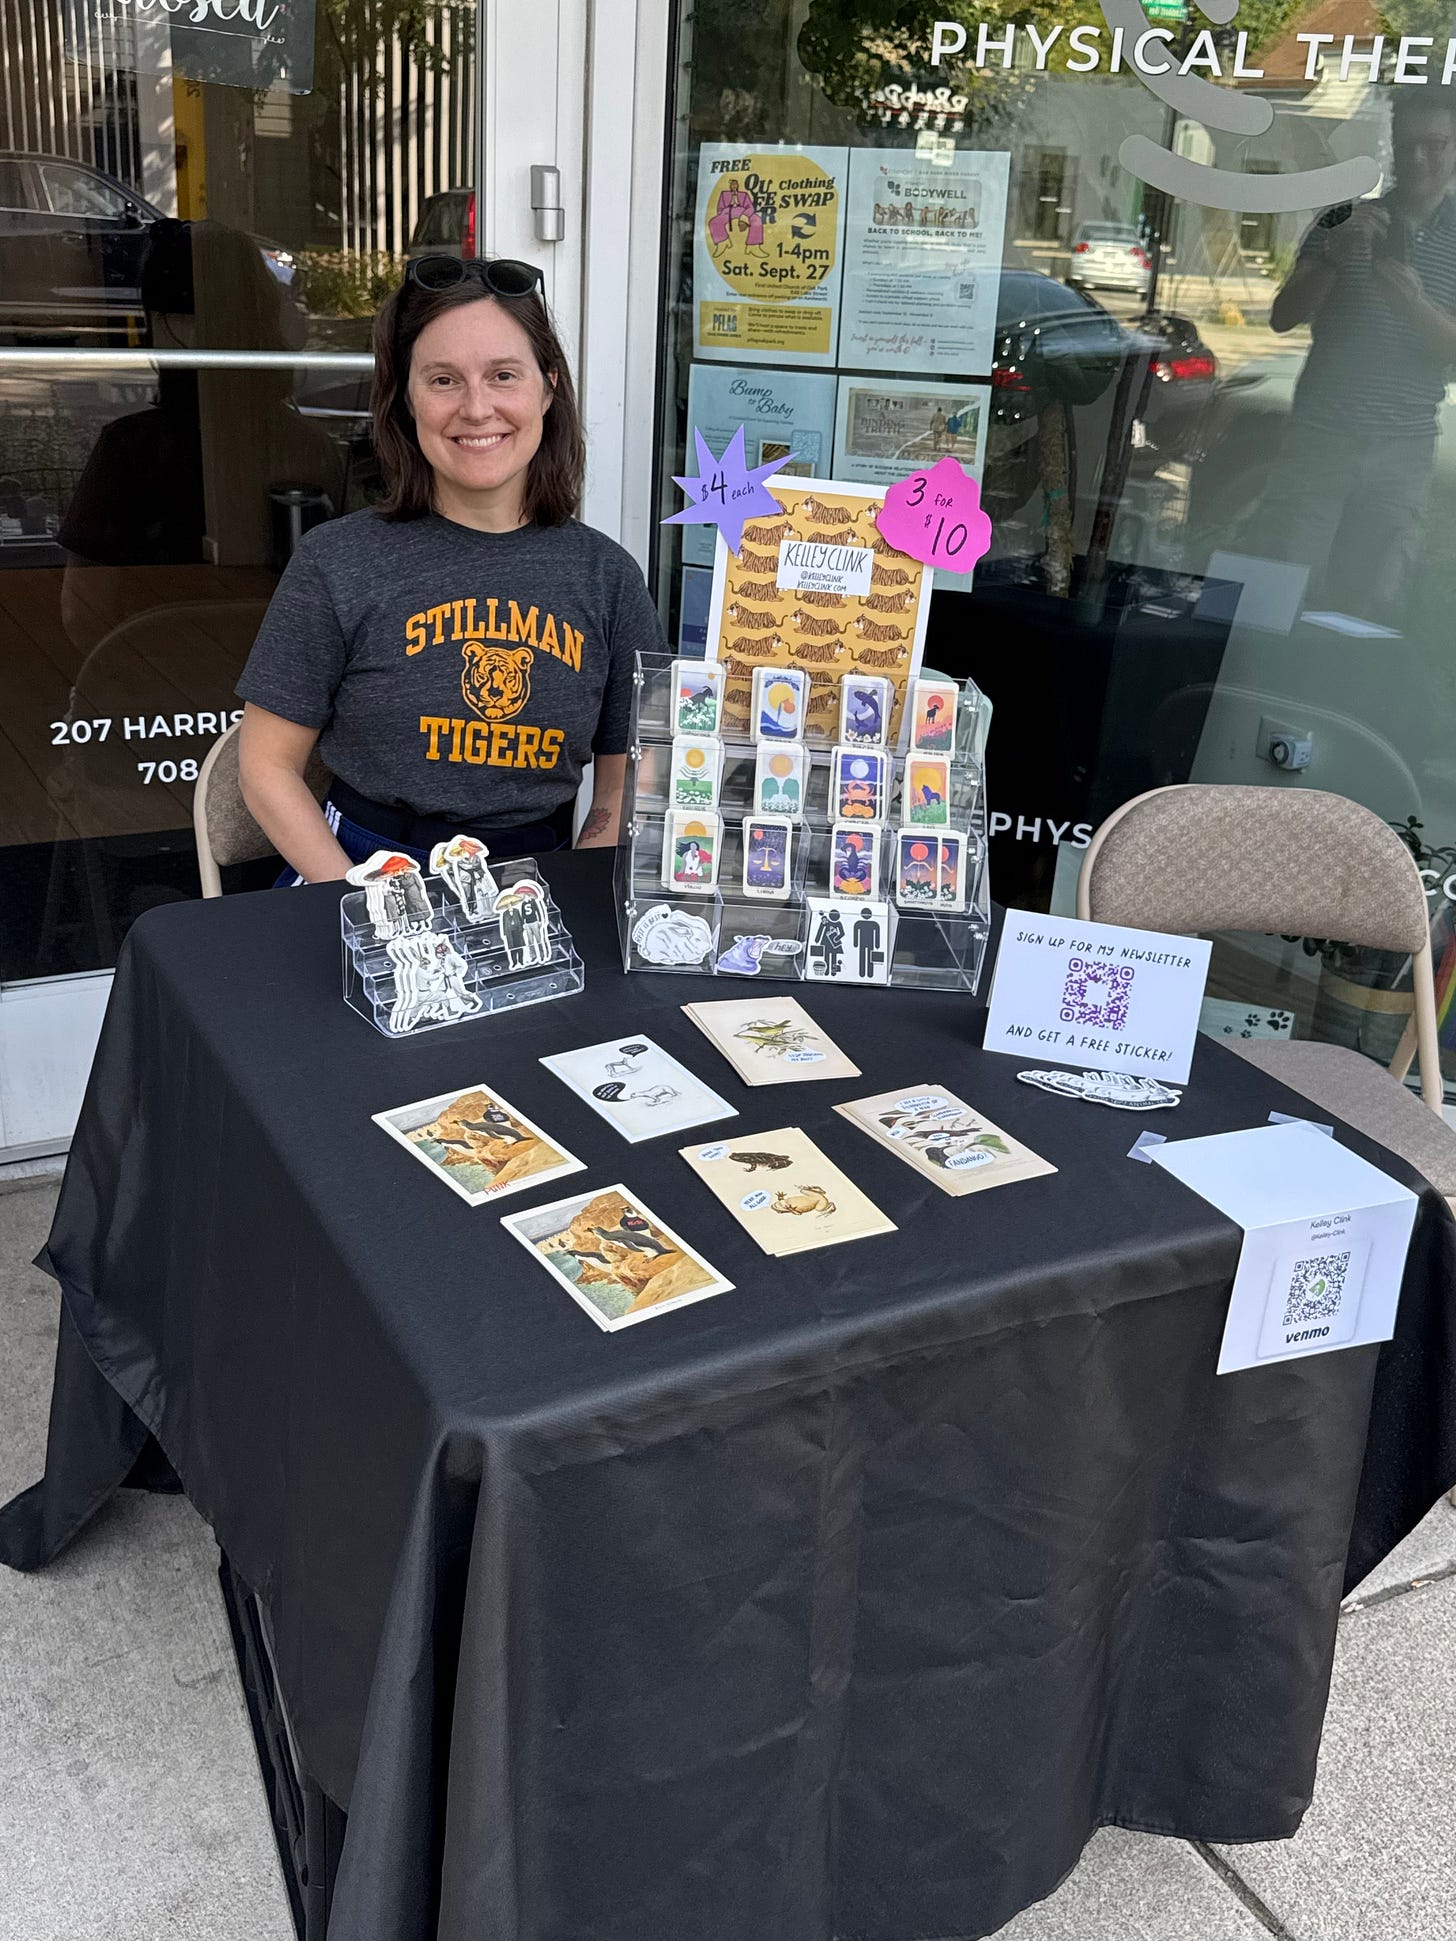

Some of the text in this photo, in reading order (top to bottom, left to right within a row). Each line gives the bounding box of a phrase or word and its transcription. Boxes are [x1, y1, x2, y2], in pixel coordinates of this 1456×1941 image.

[930, 21, 1265, 80] PHYSICAL
[710, 159, 752, 174] FREE
[779, 177, 836, 191] Clothing
[904, 188, 967, 199] BODYWELL
[779, 192, 835, 209] SWAP
[901, 229, 933, 237] SCHOOL,
[776, 242, 830, 264] 1-4pm
[722, 260, 830, 282] Sat. Sept. 27
[712, 313, 738, 333] PFLAG
[729, 379, 773, 399] Bump
[755, 397, 794, 417] Baby
[701, 471, 754, 505] $4 each
[905, 477, 926, 507] 3
[924, 513, 968, 556] $10
[784, 543, 868, 573] KELLEY CLINK
[801, 571, 844, 583] @KELLEYCLINK
[405, 598, 585, 673] STILLMAN
[50, 718, 112, 746] 207
[419, 715, 565, 769] TIGERS
[137, 758, 199, 785] 708
[989, 811, 1094, 849] PHYS
[523, 905, 532, 916] S
[1016, 931, 1192, 969] SIGN UP FOR MY NEWSLETTER
[1006, 1024, 1174, 1062] AND GET A FREE STICKER!
[1310, 1214, 1351, 1229] Kelley Clink
[1285, 1325, 1331, 1344] venmo
